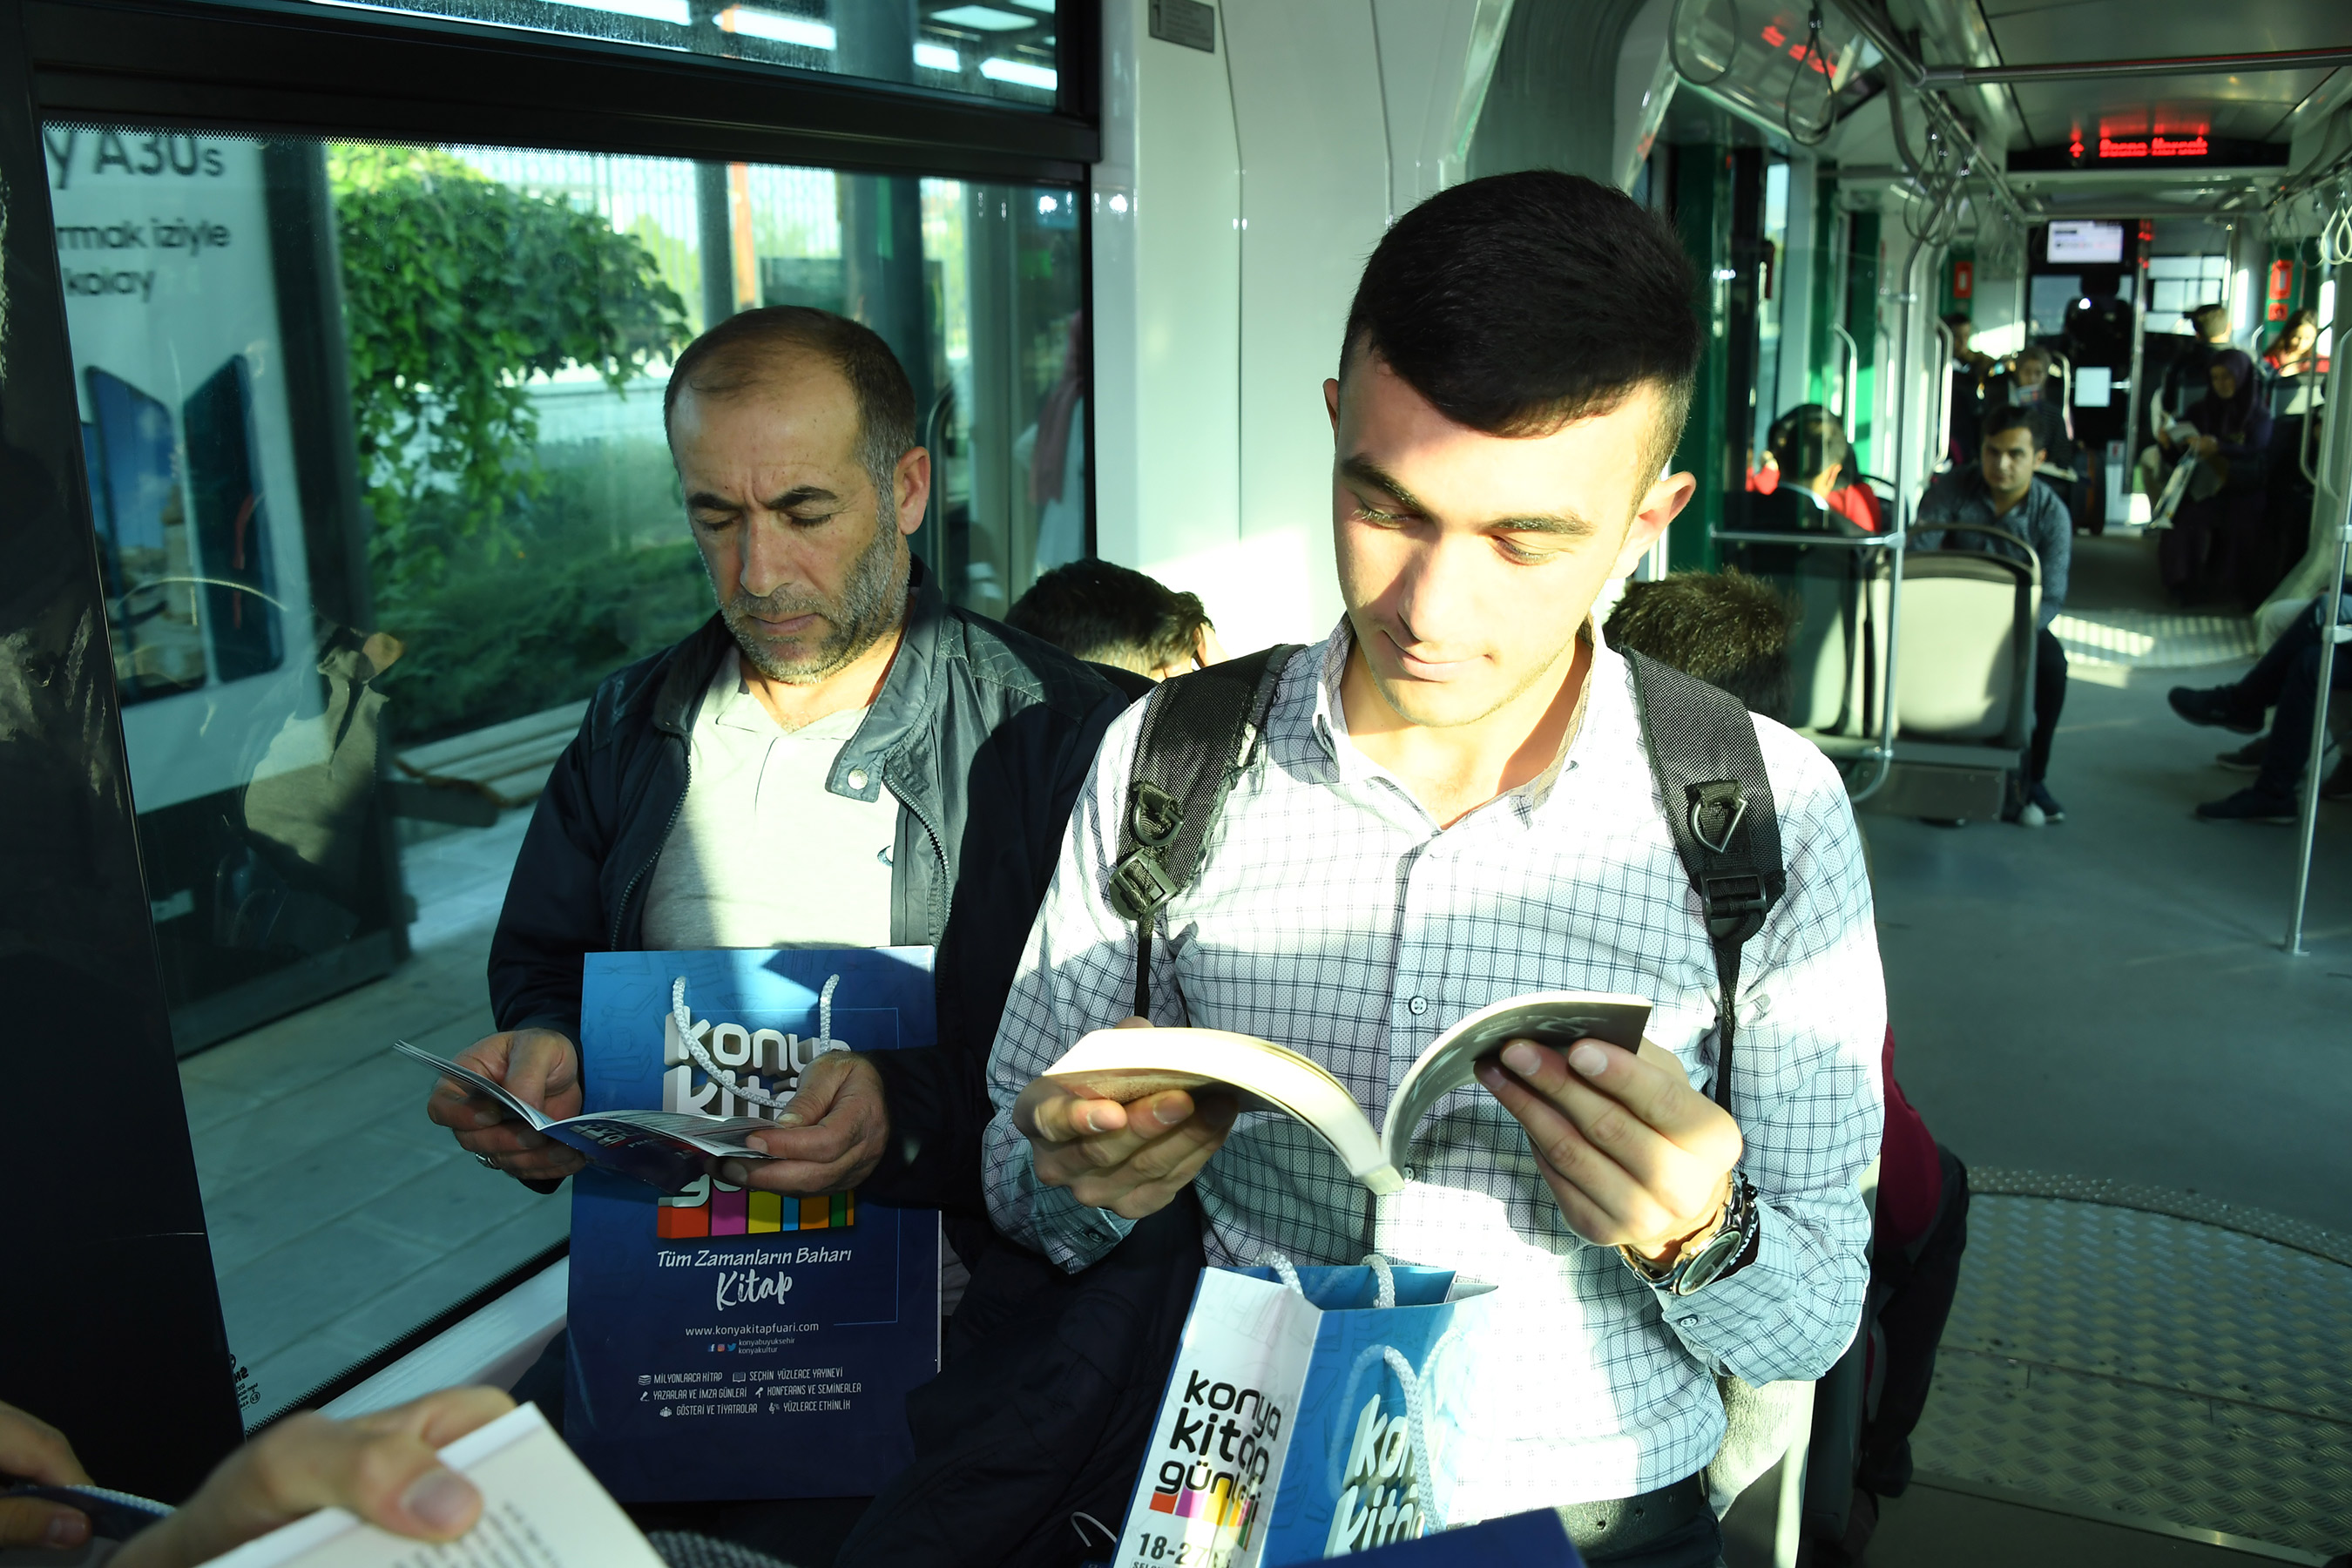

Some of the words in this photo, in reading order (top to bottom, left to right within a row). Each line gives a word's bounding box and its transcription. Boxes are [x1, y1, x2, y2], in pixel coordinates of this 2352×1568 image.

[150, 217, 231, 258] iziyle
[64, 267, 155, 304] kolay
[663, 1005, 852, 1080] kony
[662, 1064, 798, 1119] kit
[657, 1250, 692, 1267] Tüm
[694, 1248, 793, 1267] Zamanların
[795, 1247, 852, 1263] Baharı
[716, 1268, 793, 1312] Kitap
[685, 1322, 820, 1337] www.konyakitapfuari.com
[738, 1336, 795, 1348] konyabuyuksehir
[738, 1346, 778, 1355] konyakultur
[653, 1372, 701, 1384] MİLYONLARCA
[702, 1371, 723, 1382] KİTAP
[749, 1369, 774, 1382] SEÇKİN
[777, 1369, 811, 1380] YÜZLERCE
[812, 1367, 843, 1379] YAYINEVİ
[652, 1389, 687, 1401] YAZARLAR
[689, 1389, 698, 1399] VE
[699, 1388, 718, 1399] İMZA
[719, 1386, 747, 1398] GÜNLERİ
[767, 1384, 806, 1396] KONFERANS
[808, 1384, 816, 1395] VE
[817, 1382, 862, 1395] SEMİNERLER
[676, 1403, 705, 1416] GÖSTERİ
[706, 1404, 715, 1415] VE
[717, 1402, 758, 1415] TİYATROLAR
[783, 1400, 817, 1411] YÜZLERCE
[819, 1399, 851, 1410] ETKİNLİK
[1183, 1369, 1281, 1442] konya
[1169, 1406, 1269, 1486] kitap
